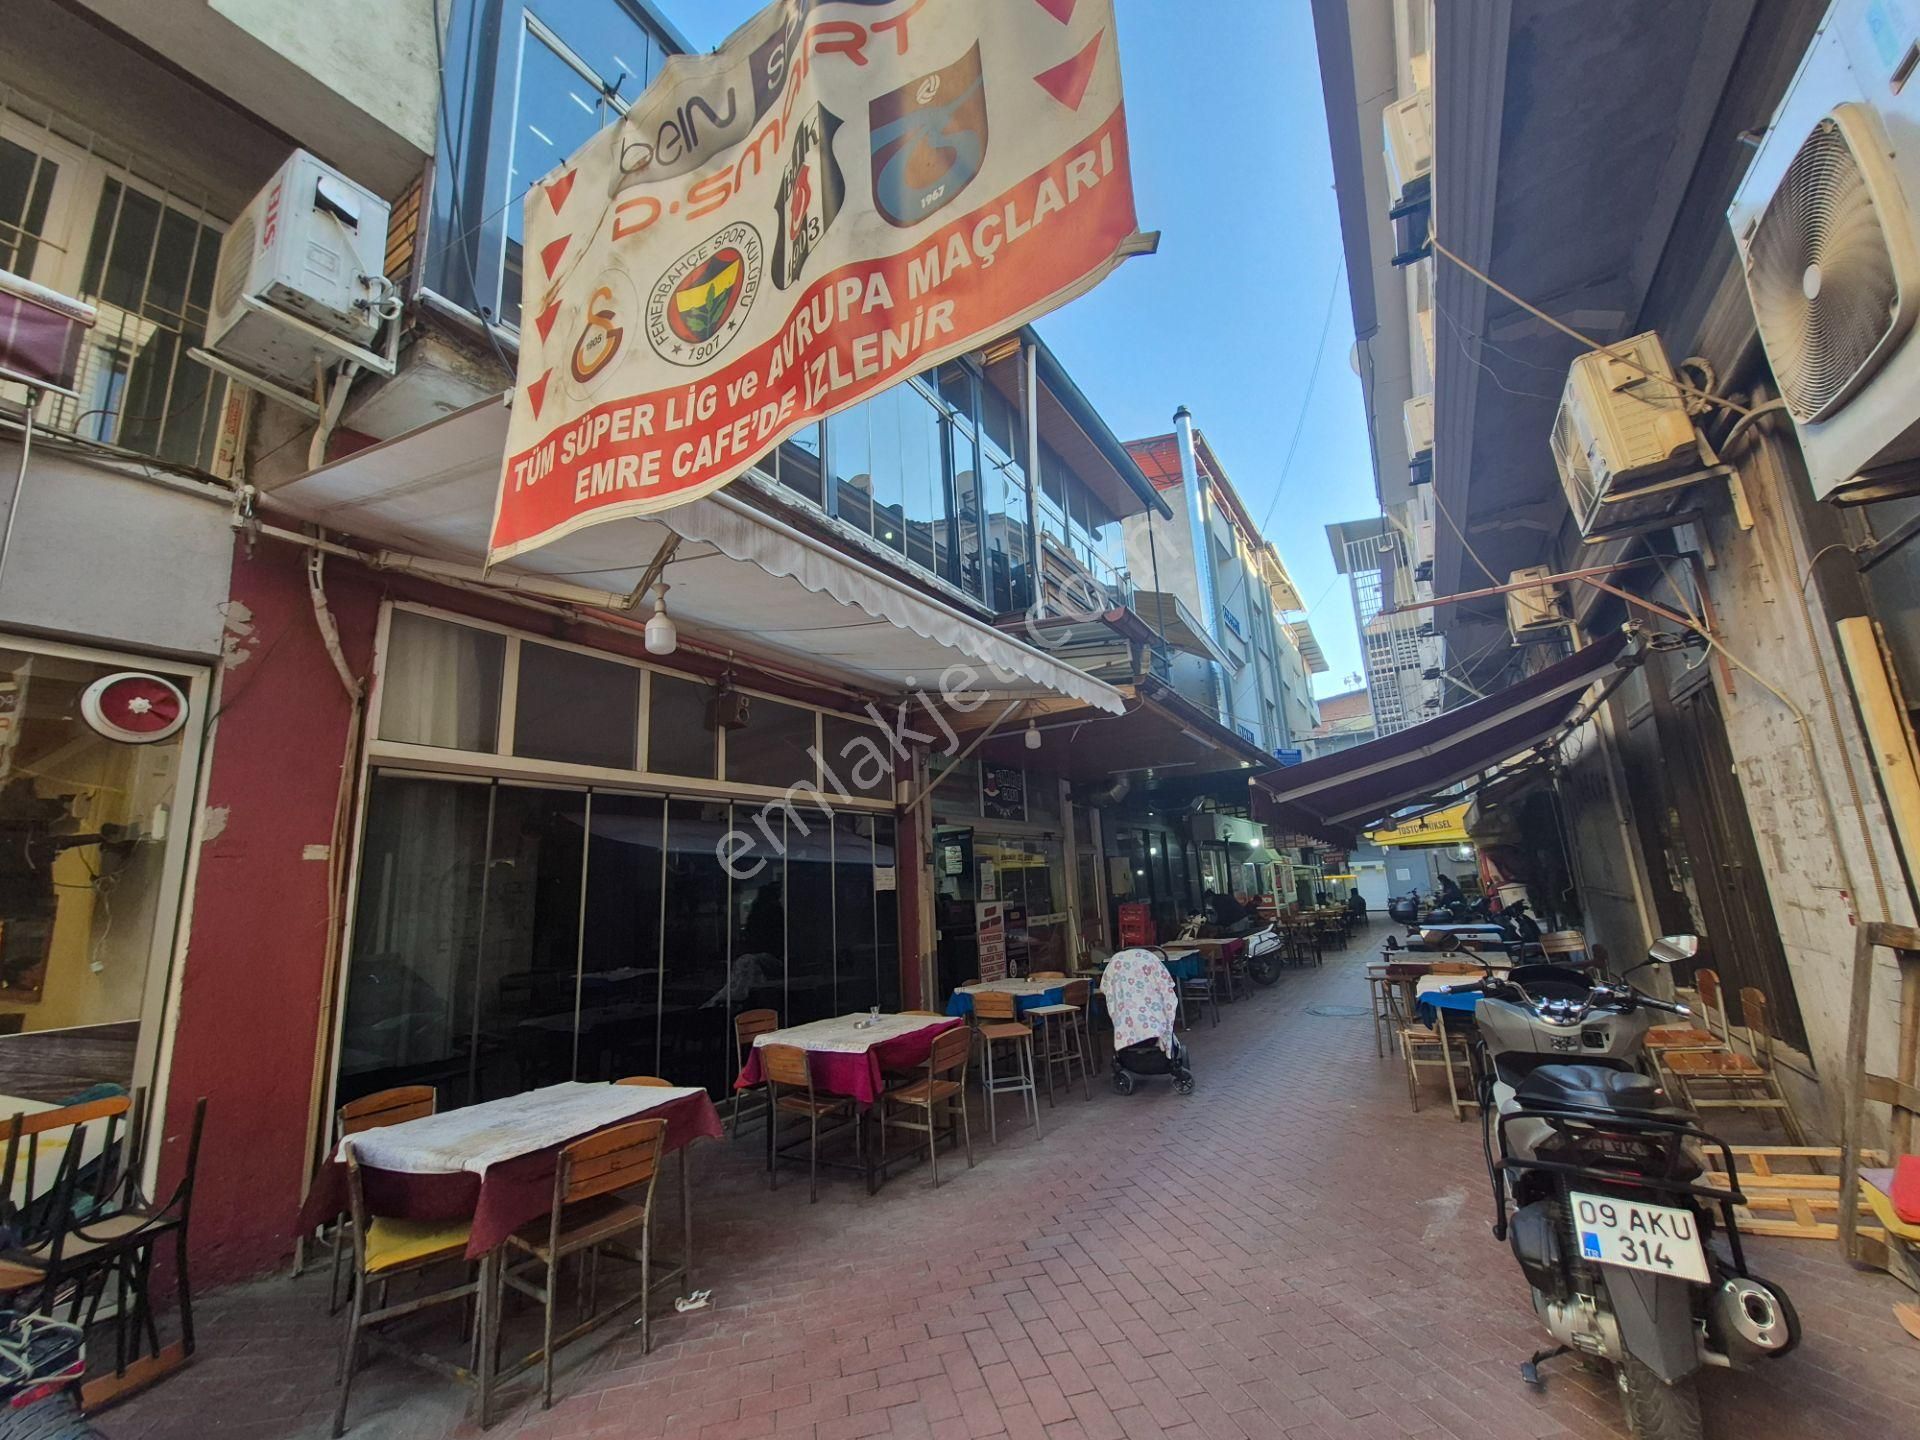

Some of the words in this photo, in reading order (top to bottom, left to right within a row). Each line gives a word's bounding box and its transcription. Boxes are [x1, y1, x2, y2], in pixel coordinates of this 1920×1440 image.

[920, 187, 945, 209] 1967
[650, 246, 709, 347] FENERBAHÇE
[713, 227, 747, 250] SPOR
[740, 237, 762, 308] KULÜBÜ
[514, 440, 557, 493] TÜM
[560, 402, 656, 465] SÜPER
[664, 380, 717, 433] LİG
[726, 370, 760, 408] ve
[766, 271, 895, 389] AVRUPA
[906, 132, 1115, 302] MAÇLARI
[586, 333, 603, 351] 1905
[688, 334, 721, 361] 1907
[574, 448, 662, 504] EMRE
[802, 299, 956, 412] İZLENİR
[1579, 1201, 1617, 1228] 09
[1630, 1209, 1691, 1240] AKU
[1619, 1236, 1674, 1269] 314
